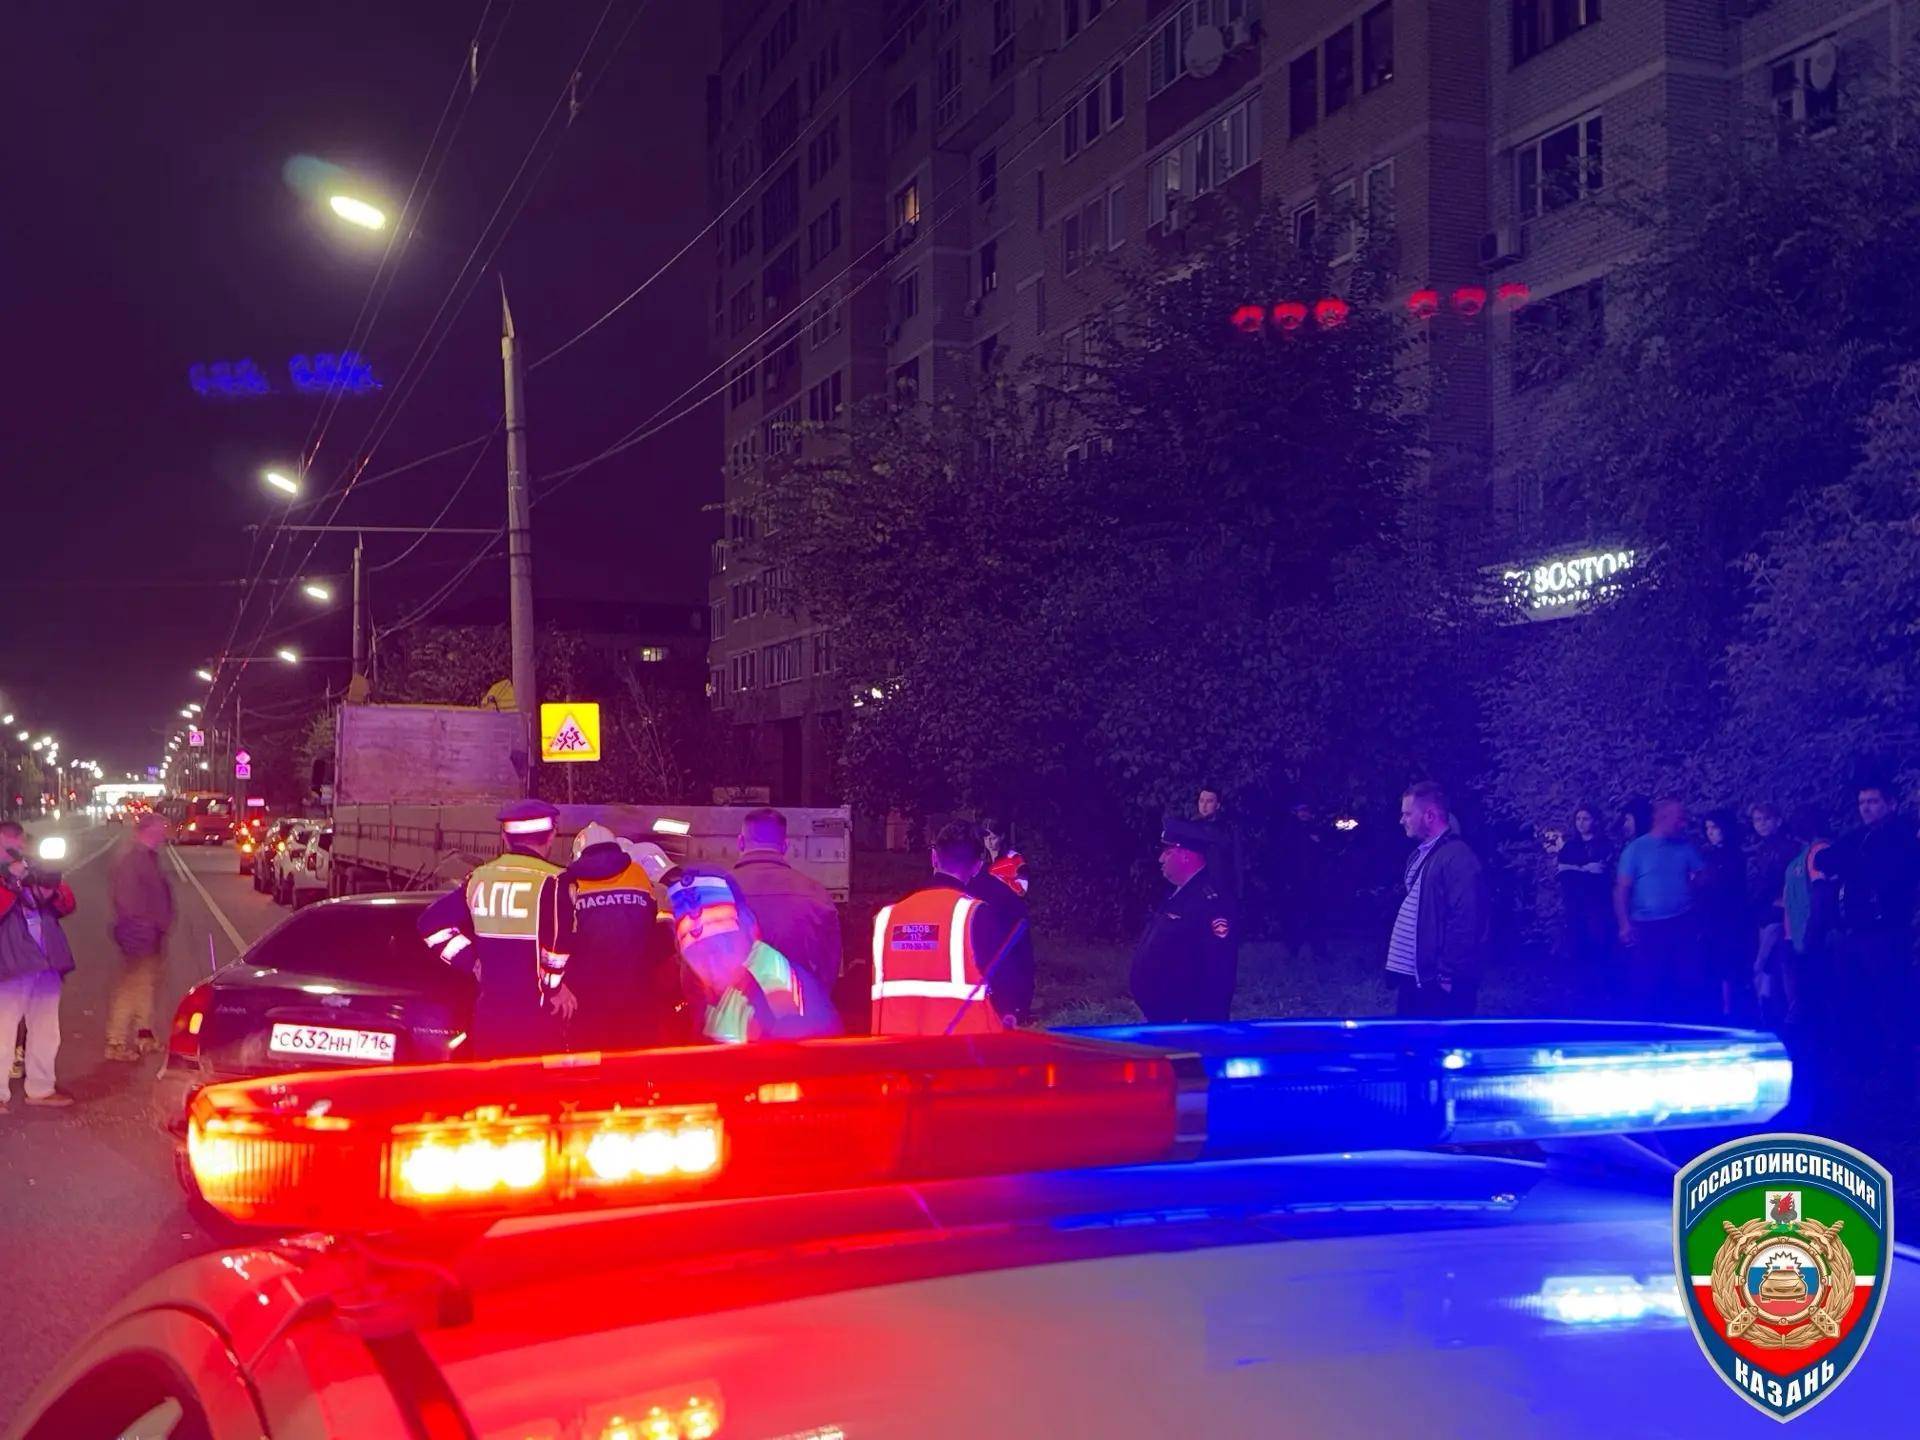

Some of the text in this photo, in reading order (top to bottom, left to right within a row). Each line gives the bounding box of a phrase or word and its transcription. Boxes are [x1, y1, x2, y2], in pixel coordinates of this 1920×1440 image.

[472, 881, 533, 918] ДПС
[575, 893, 648, 911] ПАСАТЕЛЬ
[360, 1033, 388, 1050] 716
